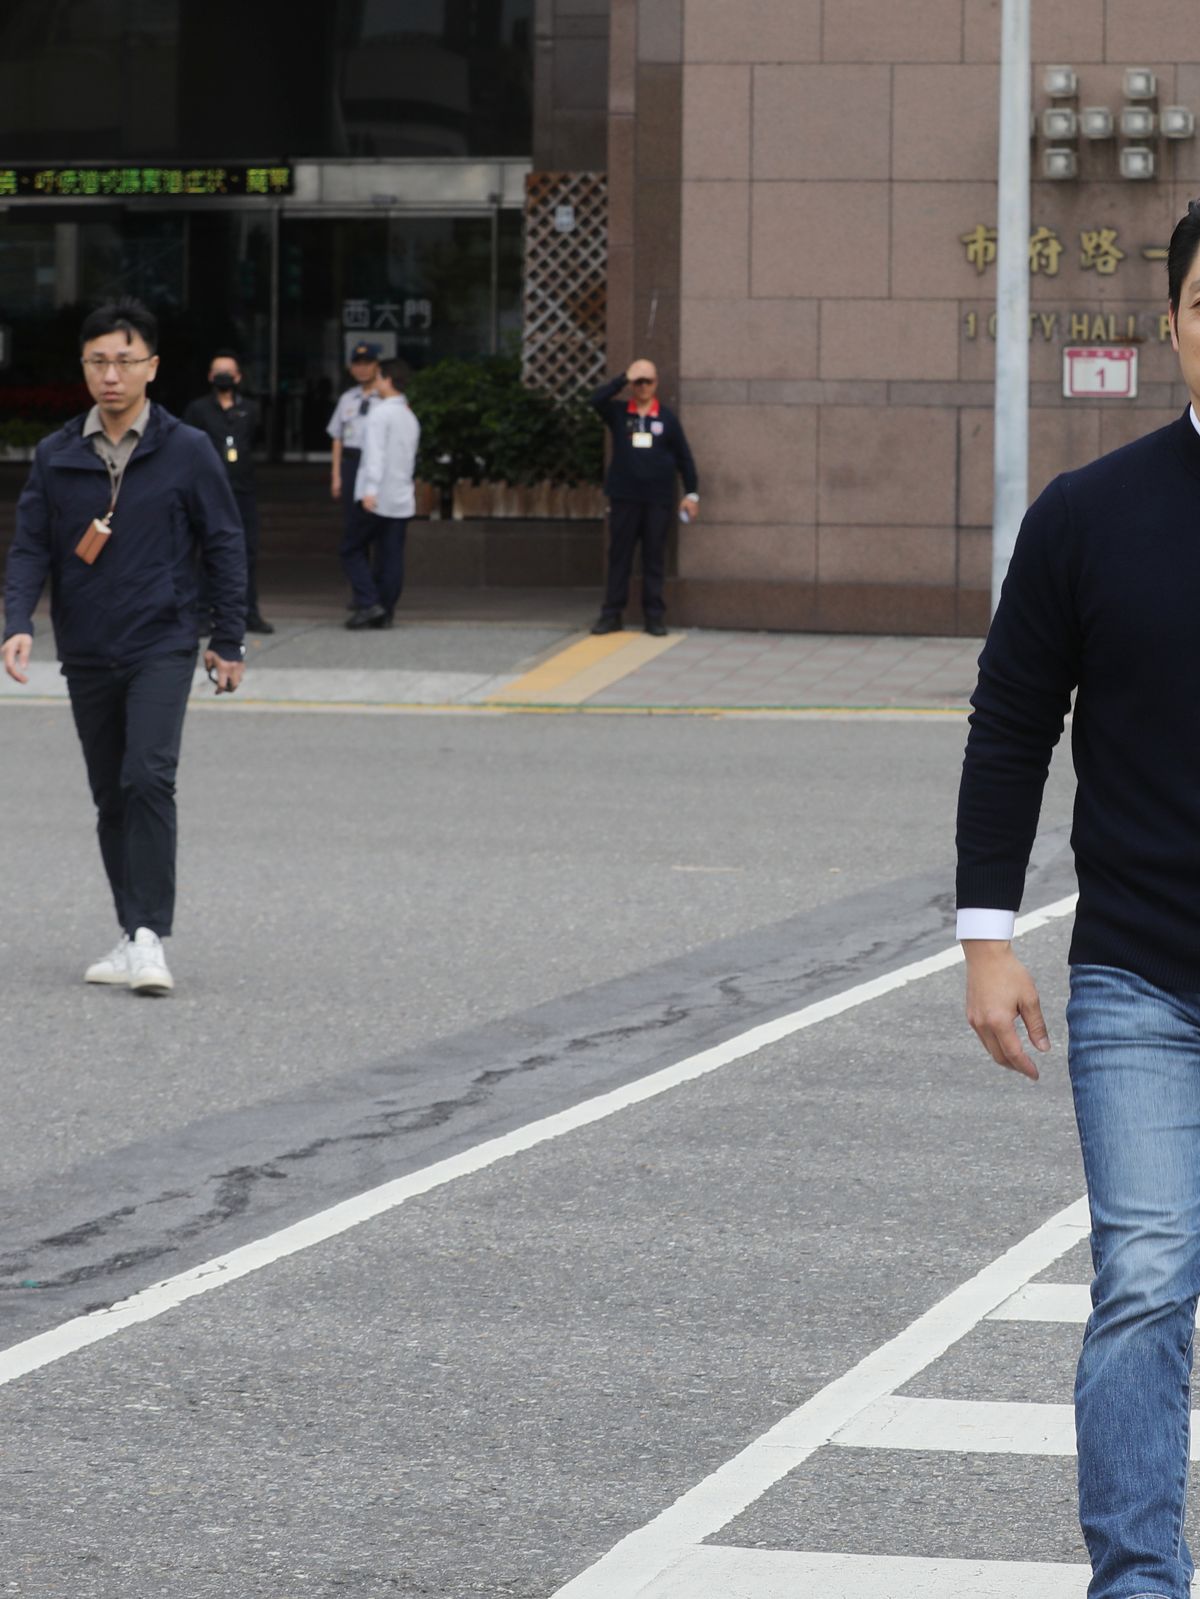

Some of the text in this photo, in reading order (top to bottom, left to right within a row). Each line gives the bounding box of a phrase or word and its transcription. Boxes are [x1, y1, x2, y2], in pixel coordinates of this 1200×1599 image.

[342, 299, 432, 329] 西大門
[1095, 367, 1105, 388] 1
